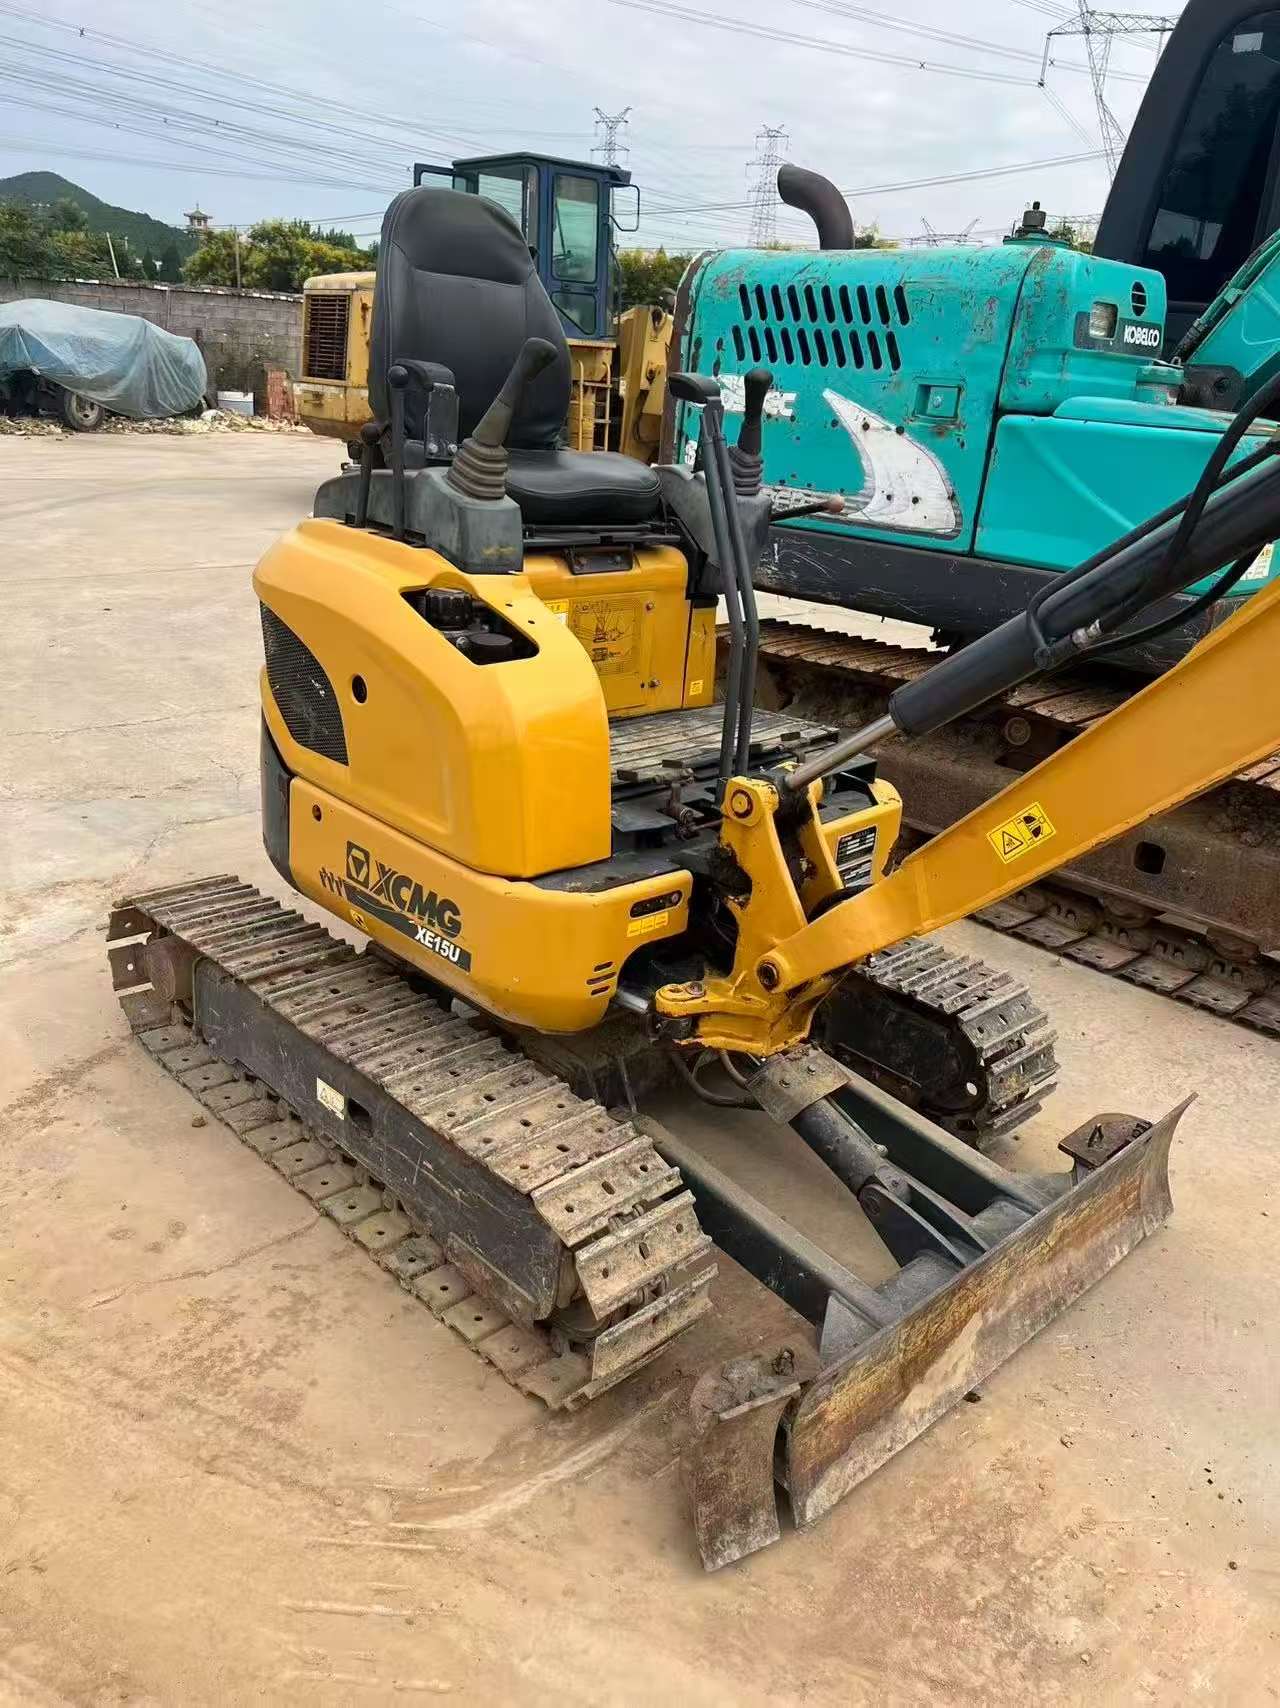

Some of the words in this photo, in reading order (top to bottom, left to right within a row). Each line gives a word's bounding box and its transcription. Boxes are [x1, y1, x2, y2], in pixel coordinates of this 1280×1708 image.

[1124, 325, 1160, 347] KOBELCO
[369, 860, 462, 939] XCMG
[415, 926, 461, 962] XE15U
